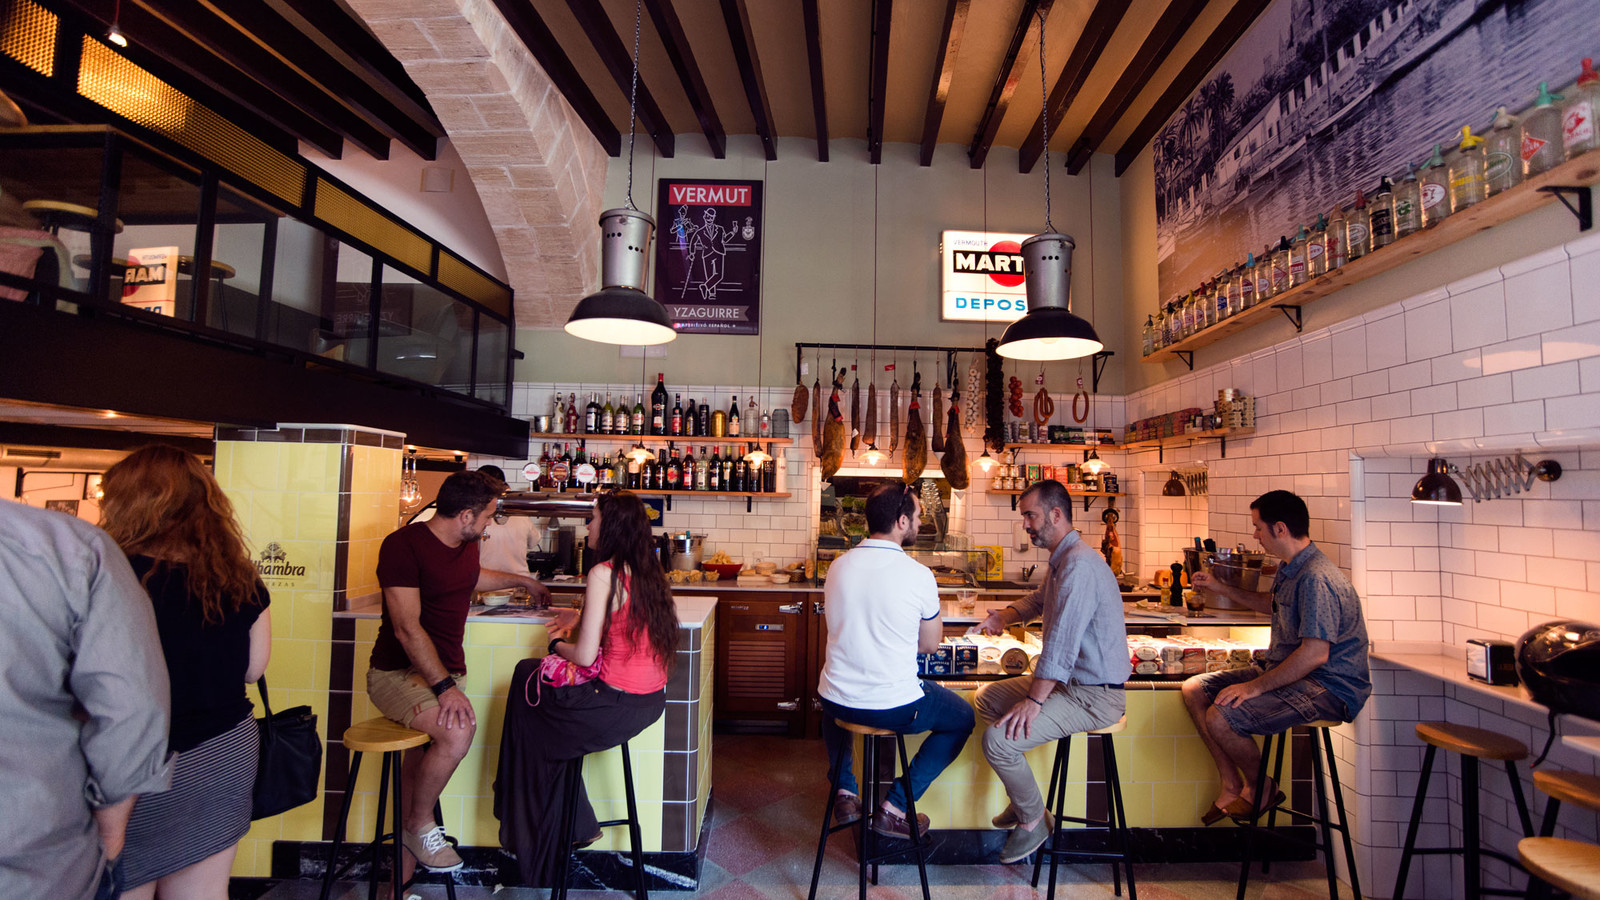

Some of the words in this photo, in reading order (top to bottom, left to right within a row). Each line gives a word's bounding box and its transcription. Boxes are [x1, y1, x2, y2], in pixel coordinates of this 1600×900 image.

[672, 186, 749, 204] VERMUT
[955, 252, 1024, 273] MART
[956, 297, 1026, 311] DEPOS
[673, 306, 740, 319] YZAGUIRRE
